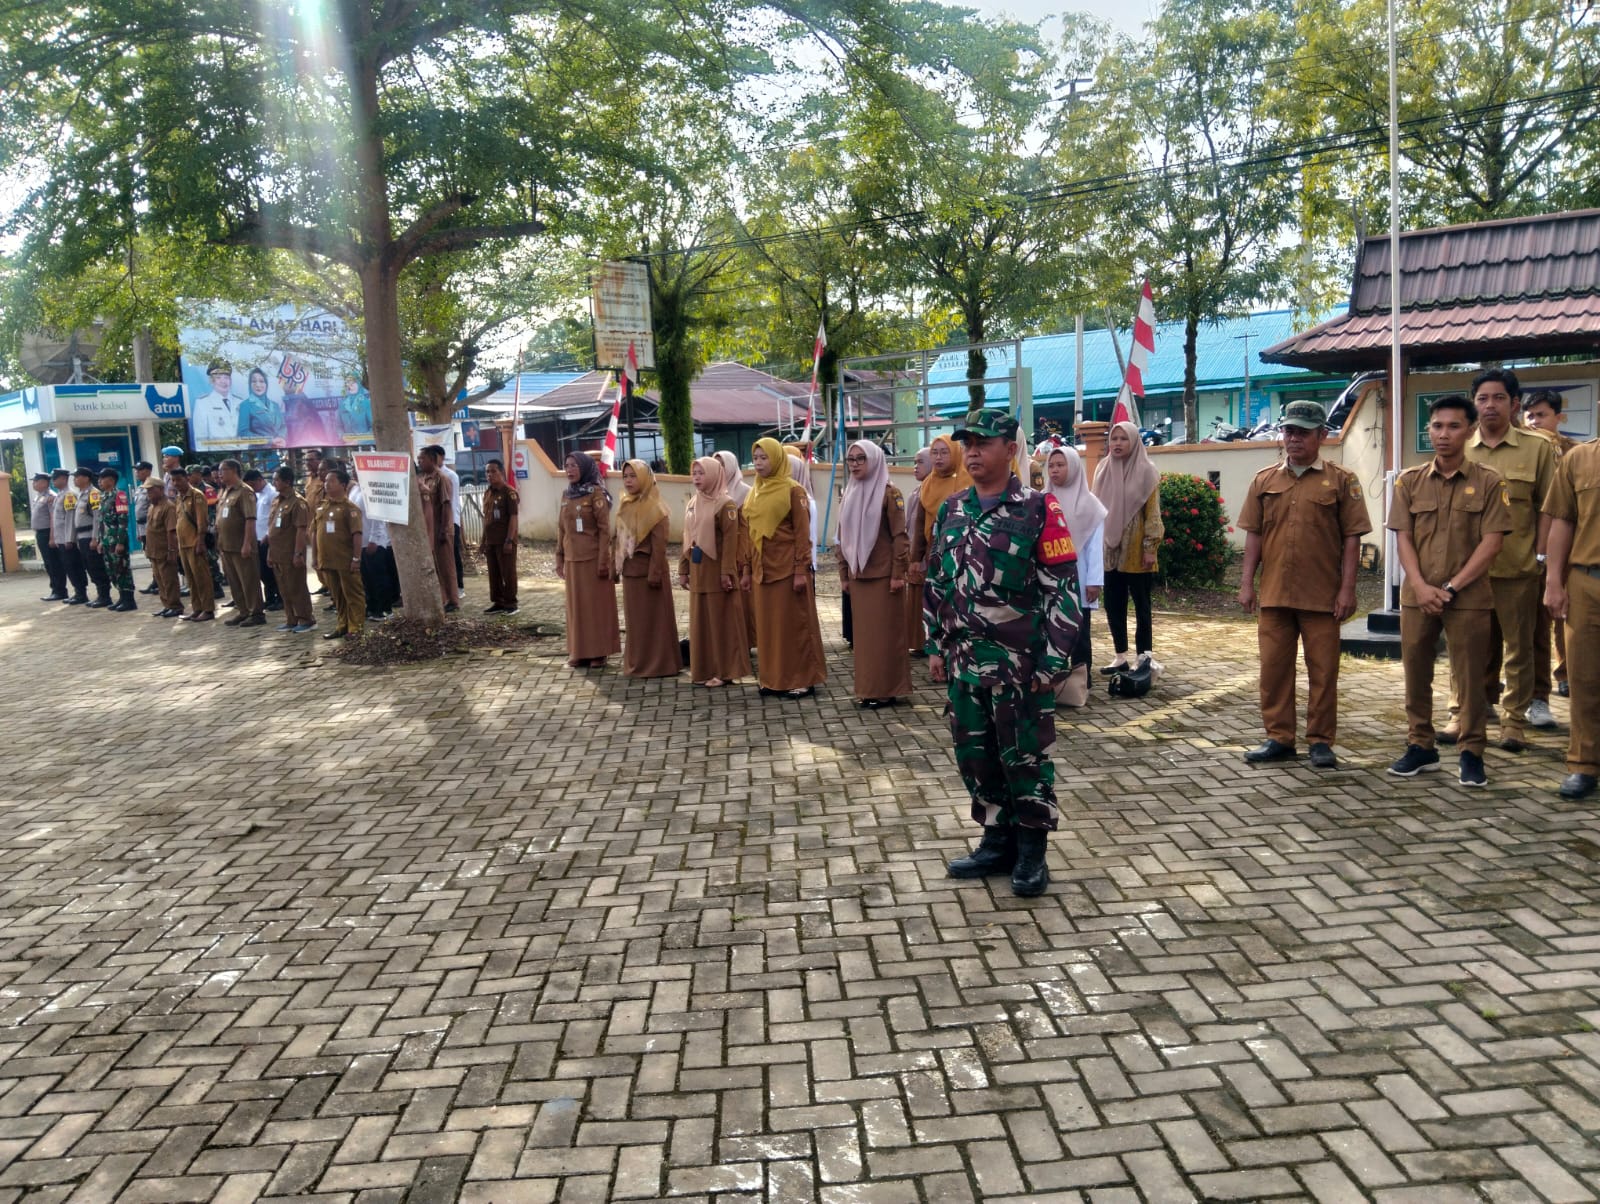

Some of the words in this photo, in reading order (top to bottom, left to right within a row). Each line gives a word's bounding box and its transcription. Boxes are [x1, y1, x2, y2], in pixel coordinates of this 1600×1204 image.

[301, 319, 338, 333] HARI
[73, 401, 98, 412] bank
[100, 400, 128, 411] kalsel
[154, 402, 182, 414] atm
